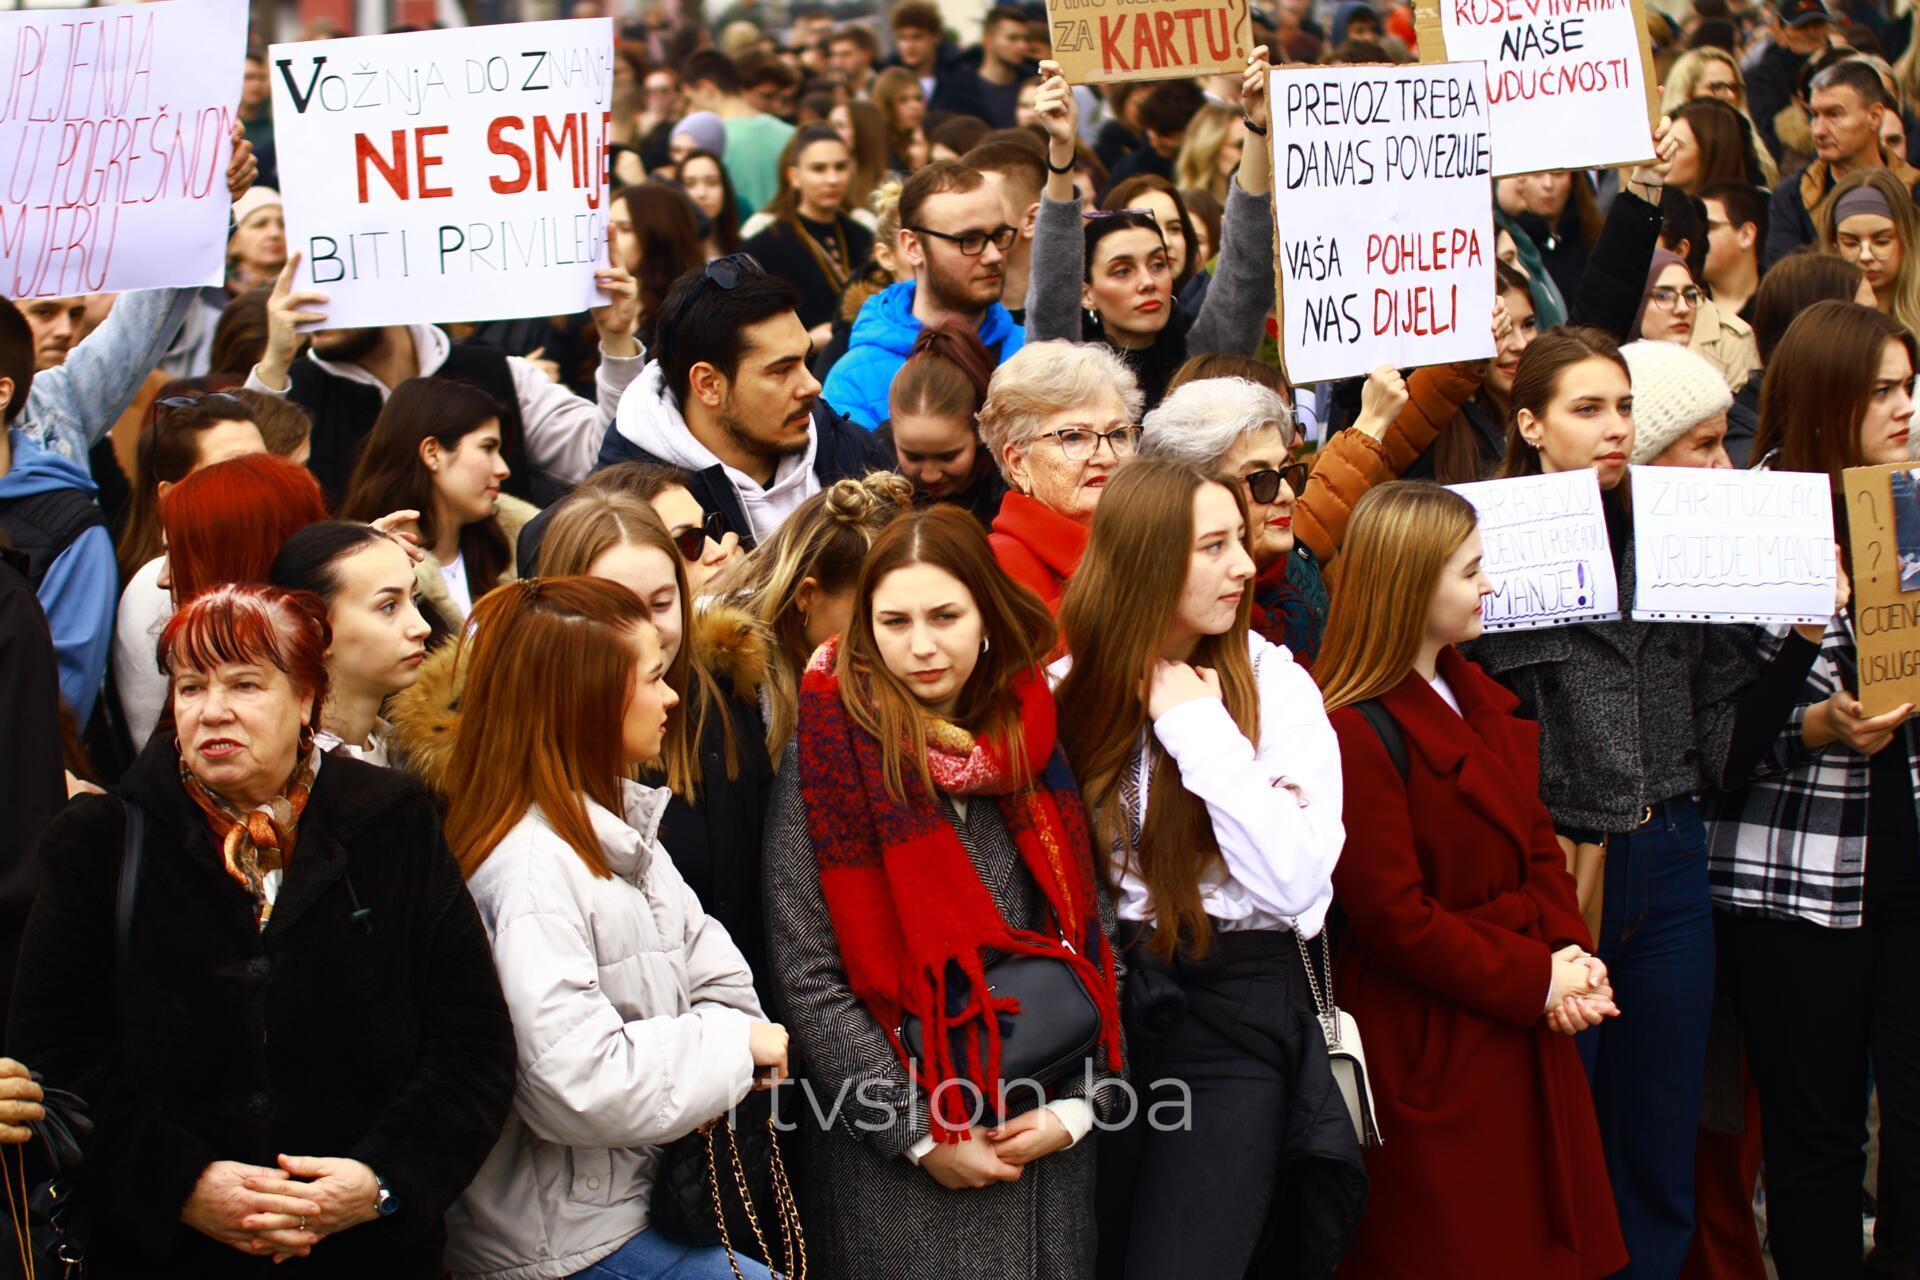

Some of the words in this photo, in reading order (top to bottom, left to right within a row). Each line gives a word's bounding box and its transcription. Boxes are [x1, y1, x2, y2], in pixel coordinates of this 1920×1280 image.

[1055, 20, 1094, 52] ZA
[1099, 0, 1248, 75] KARTU?
[1500, 19, 1584, 61] NAŠE
[465, 56, 510, 94] DO
[1486, 58, 1629, 104] UDUĆNOSTI
[1287, 81, 1390, 127] PREVOZ
[1395, 79, 1480, 120] TREBA
[9, 125, 46, 204] U
[354, 125, 454, 204] NE
[1287, 140, 1374, 189] DANAS
[1386, 133, 1489, 182] POVEZUJE
[310, 230, 409, 283] BITI
[1285, 235, 1342, 281] VAŠA
[1366, 228, 1482, 275] POHLEPA
[1302, 293, 1361, 347] NAS
[1373, 284, 1457, 337] DIJELI
[1477, 477, 1593, 526] ARAJEVU
[1649, 480, 1711, 517] ZAR
[1482, 529, 1549, 568] DENTI
[1649, 534, 1749, 580] VRIJEDE
[1489, 562, 1587, 616] MANJE!
